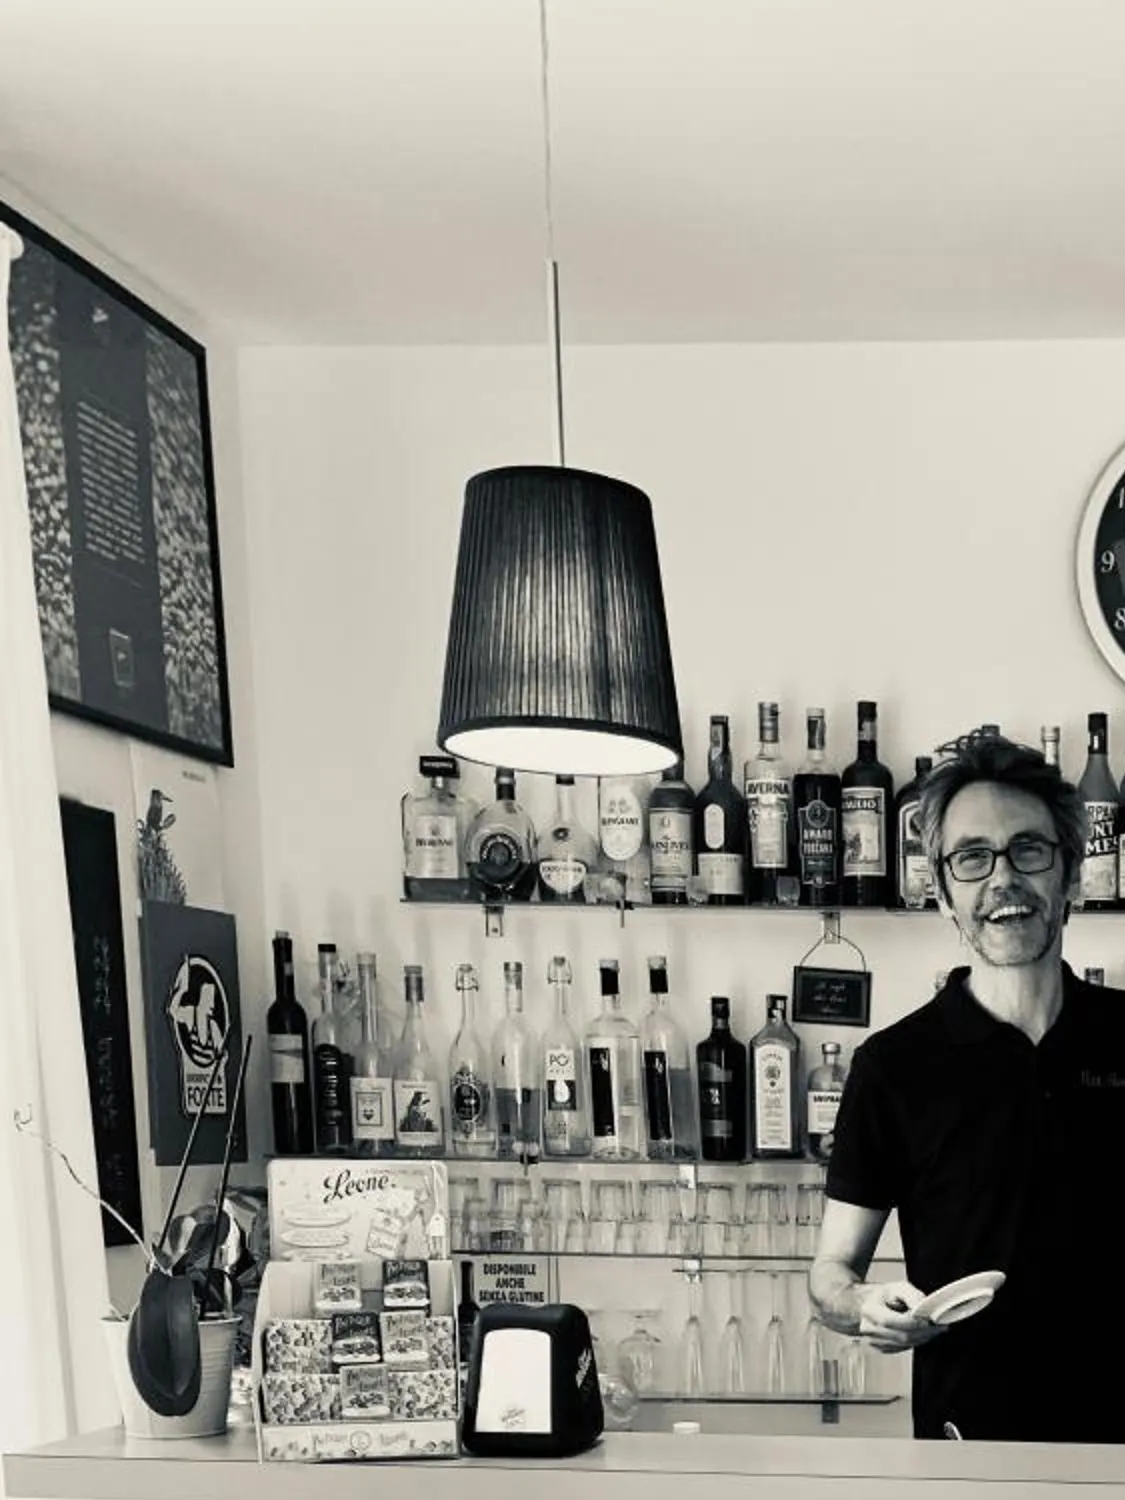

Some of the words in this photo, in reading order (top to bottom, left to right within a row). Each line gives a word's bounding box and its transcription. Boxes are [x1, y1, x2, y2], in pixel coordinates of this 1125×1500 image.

[1101, 551, 1116, 573] 9
[746, 780, 790, 796] AVERNA
[483, 1263, 537, 1276] DISPONIBILE
[495, 1277, 525, 1289] ANCHE
[479, 1289, 507, 1302] SENZA
[509, 1290, 545, 1303] GLUTINE
